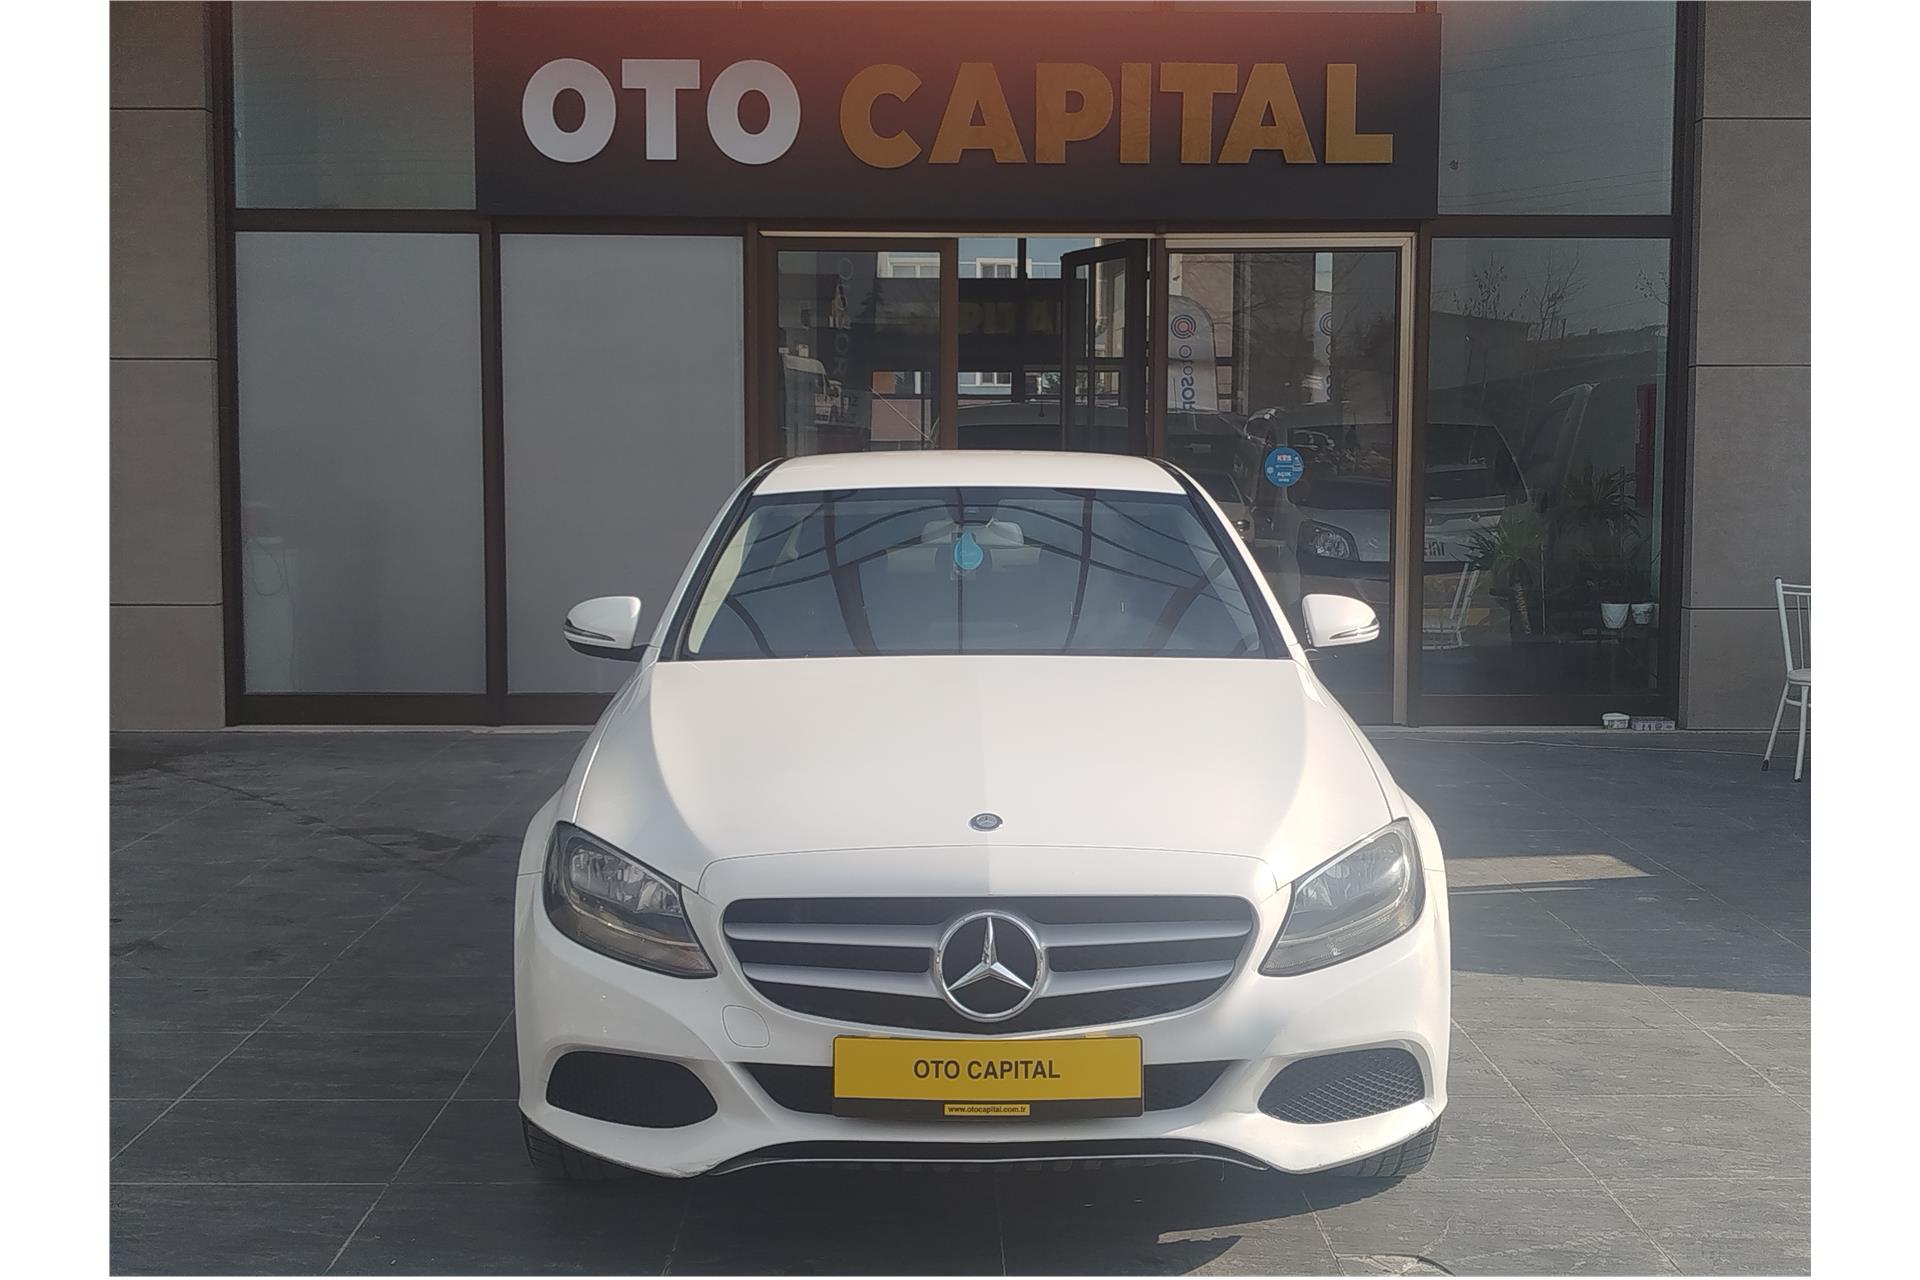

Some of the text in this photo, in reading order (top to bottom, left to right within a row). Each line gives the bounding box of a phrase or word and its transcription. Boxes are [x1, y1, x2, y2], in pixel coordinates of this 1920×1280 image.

[521, 57, 1395, 168] OTO CAPITAL
[913, 1059, 1062, 1080] OTO CAPITAL
[947, 1105, 1027, 1115] www.otocapital.com.tr
